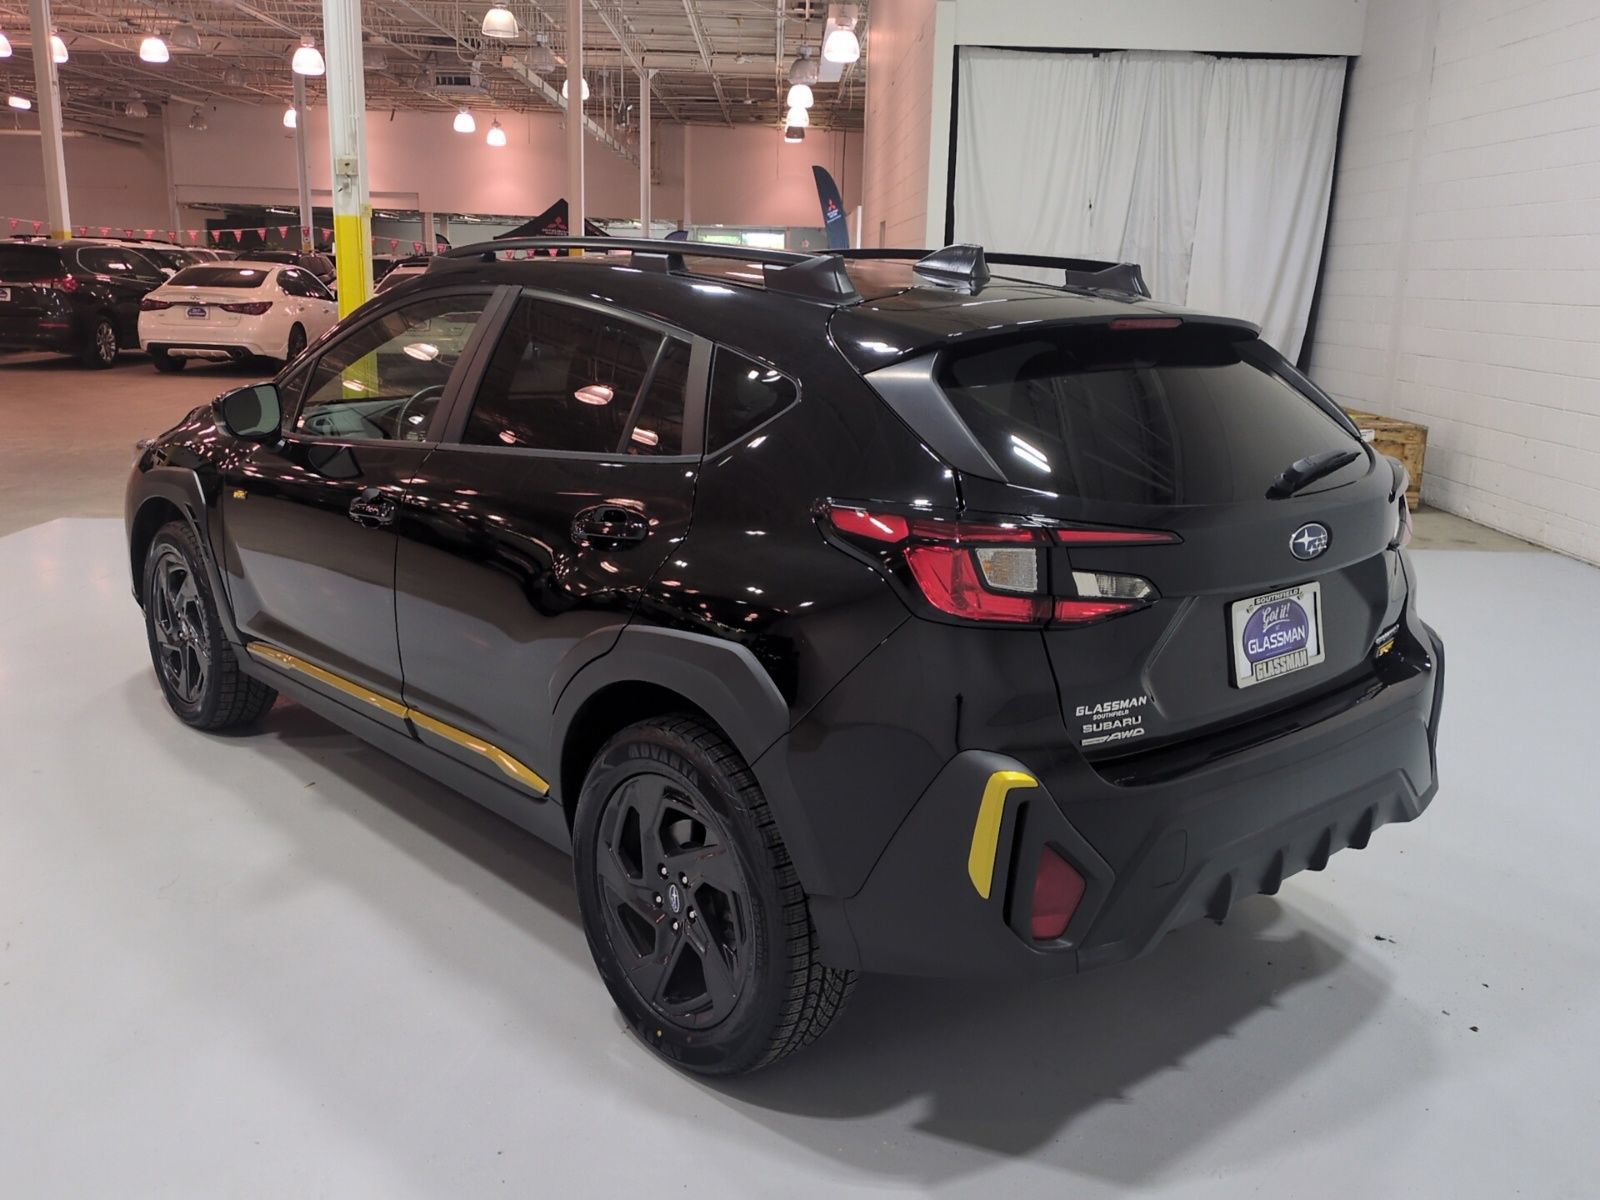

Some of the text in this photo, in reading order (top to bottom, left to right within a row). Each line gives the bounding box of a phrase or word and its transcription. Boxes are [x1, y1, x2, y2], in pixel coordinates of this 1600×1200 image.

[1255, 588, 1300, 605] SOUTHFIELD
[1262, 602, 1291, 629] Got it!
[1247, 625, 1306, 654] GLASSMAN
[1255, 649, 1308, 681] GLASSMAN
[1075, 695, 1147, 717] GLASSMAN
[1092, 709, 1130, 721] SOUTHFIELD
[1082, 715, 1142, 733] SUBARU
[1106, 727, 1145, 742] AWD
